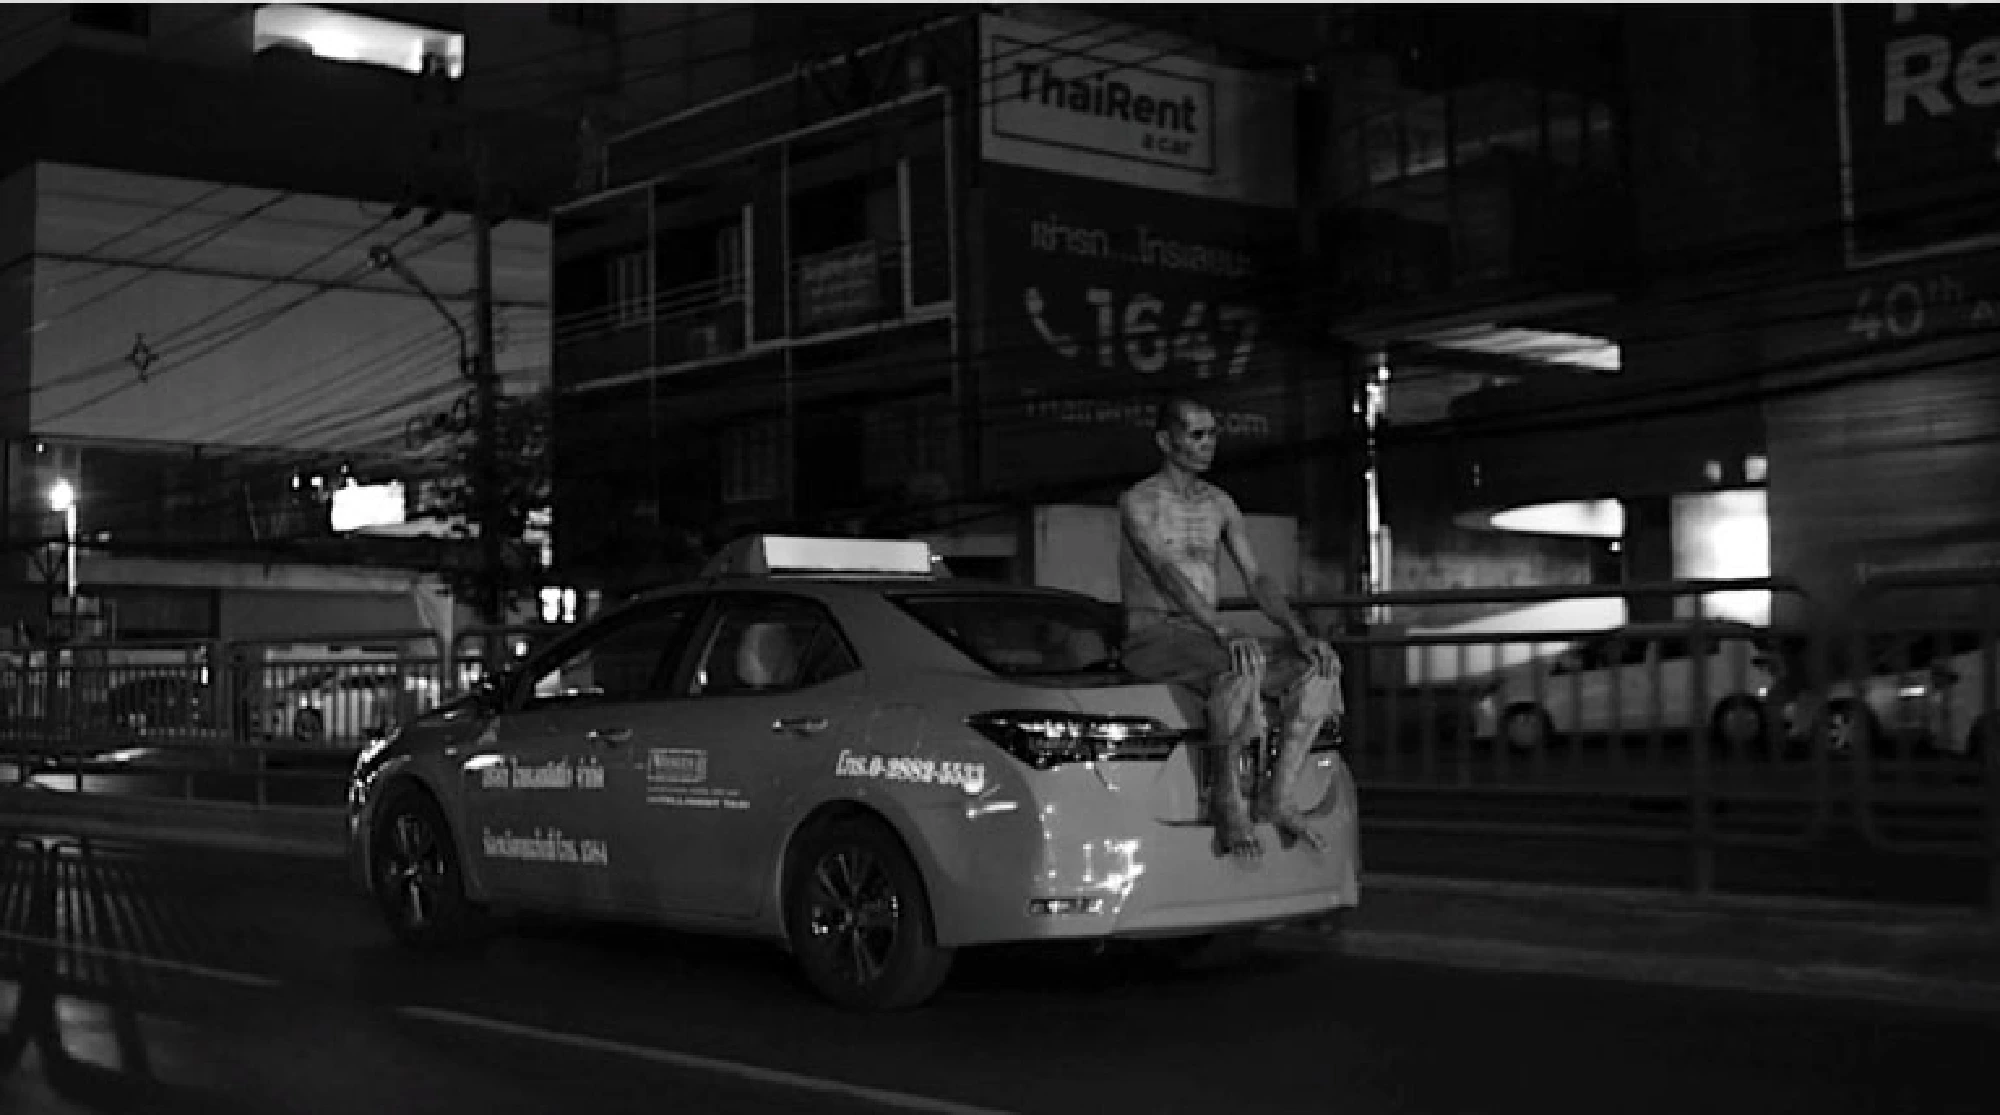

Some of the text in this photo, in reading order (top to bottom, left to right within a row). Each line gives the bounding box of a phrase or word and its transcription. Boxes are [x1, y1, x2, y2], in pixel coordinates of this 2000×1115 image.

[1014, 61, 1197, 134] ThaiRent
[1142, 132, 1192, 155] a car
[1086, 286, 1258, 380] 1647
